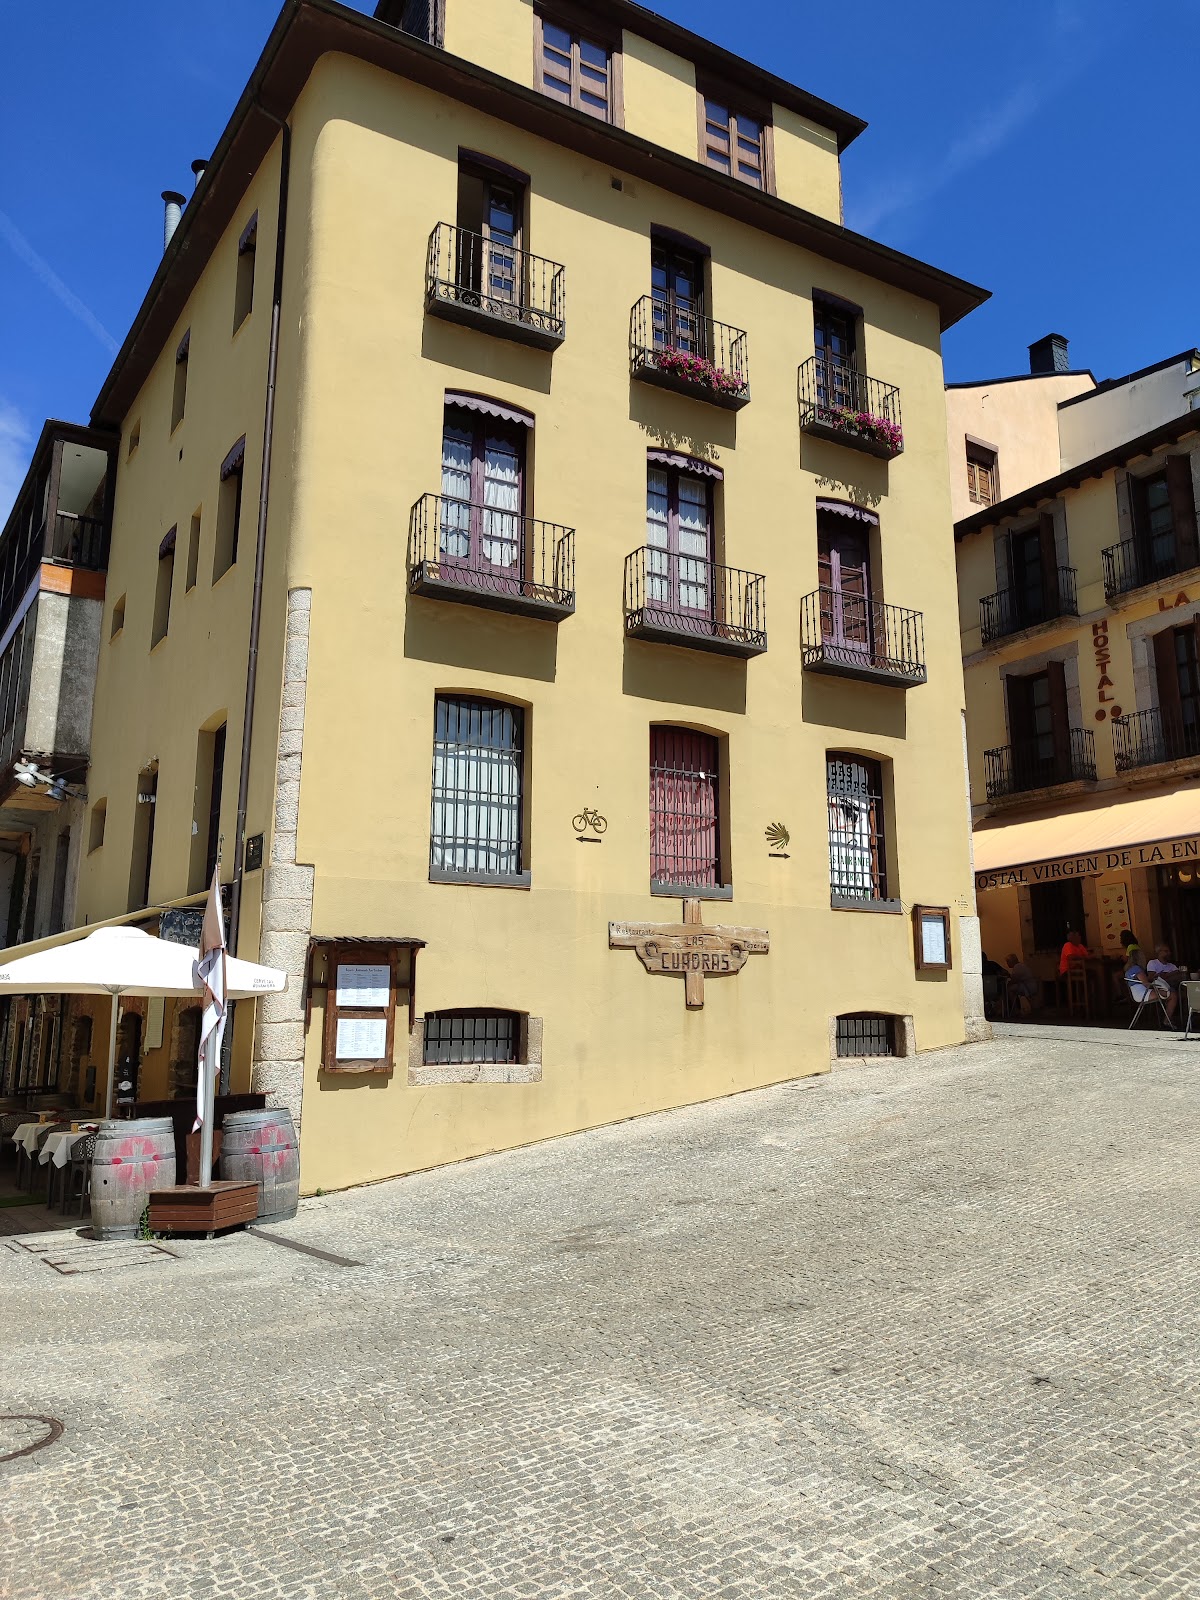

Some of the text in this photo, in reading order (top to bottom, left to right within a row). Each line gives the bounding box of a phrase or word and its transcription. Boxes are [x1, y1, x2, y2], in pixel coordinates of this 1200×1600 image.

[1158, 591, 1191, 611] LA
[1092, 620, 1114, 703] HOSTAL
[1032, 857, 1099, 880] VIRGEN
[1105, 851, 1132, 869] DE
[1138, 846, 1165, 864] LA
[685, 936, 704, 946] LAS
[661, 952, 730, 971] CUADRAS
